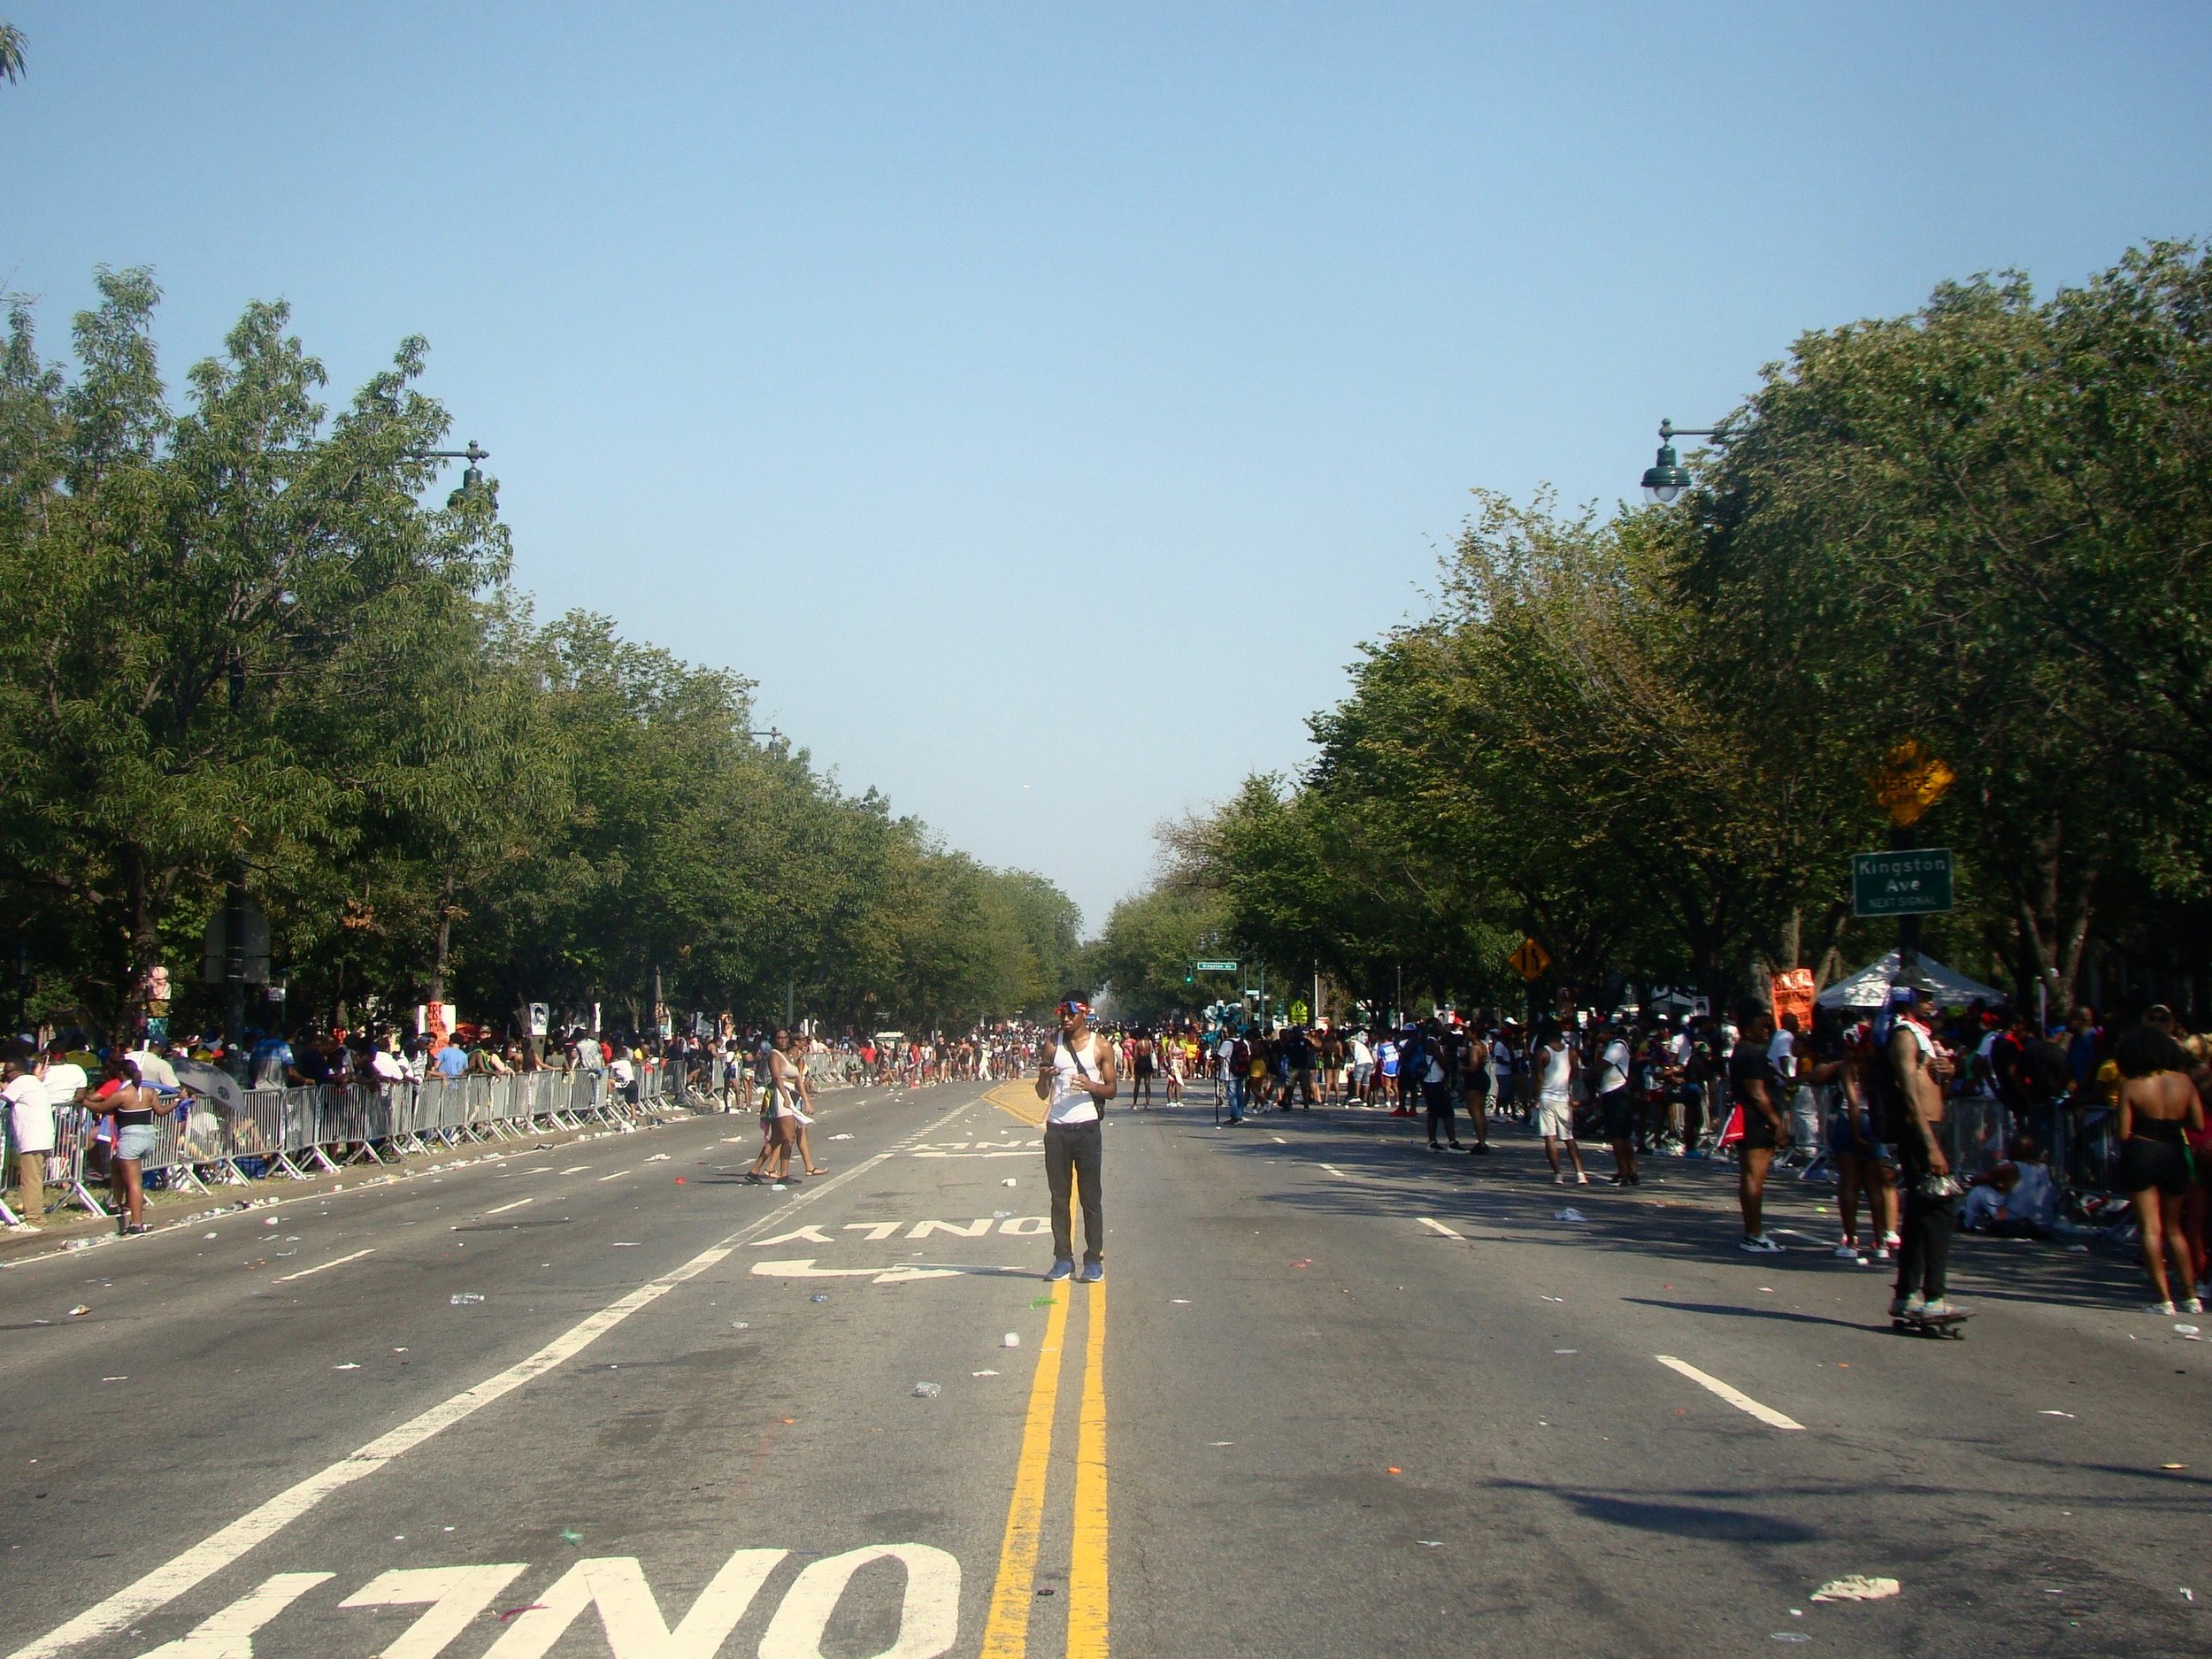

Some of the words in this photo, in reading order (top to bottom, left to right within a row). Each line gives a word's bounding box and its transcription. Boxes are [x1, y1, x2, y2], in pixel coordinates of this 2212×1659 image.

[1859, 858, 1946, 876] Kingston
[1885, 879, 1921, 892] Ave
[1869, 897, 1895, 908] NEXT
[1899, 895, 1937, 907] SIGNAL
[749, 1217, 1053, 1246] ONLY
